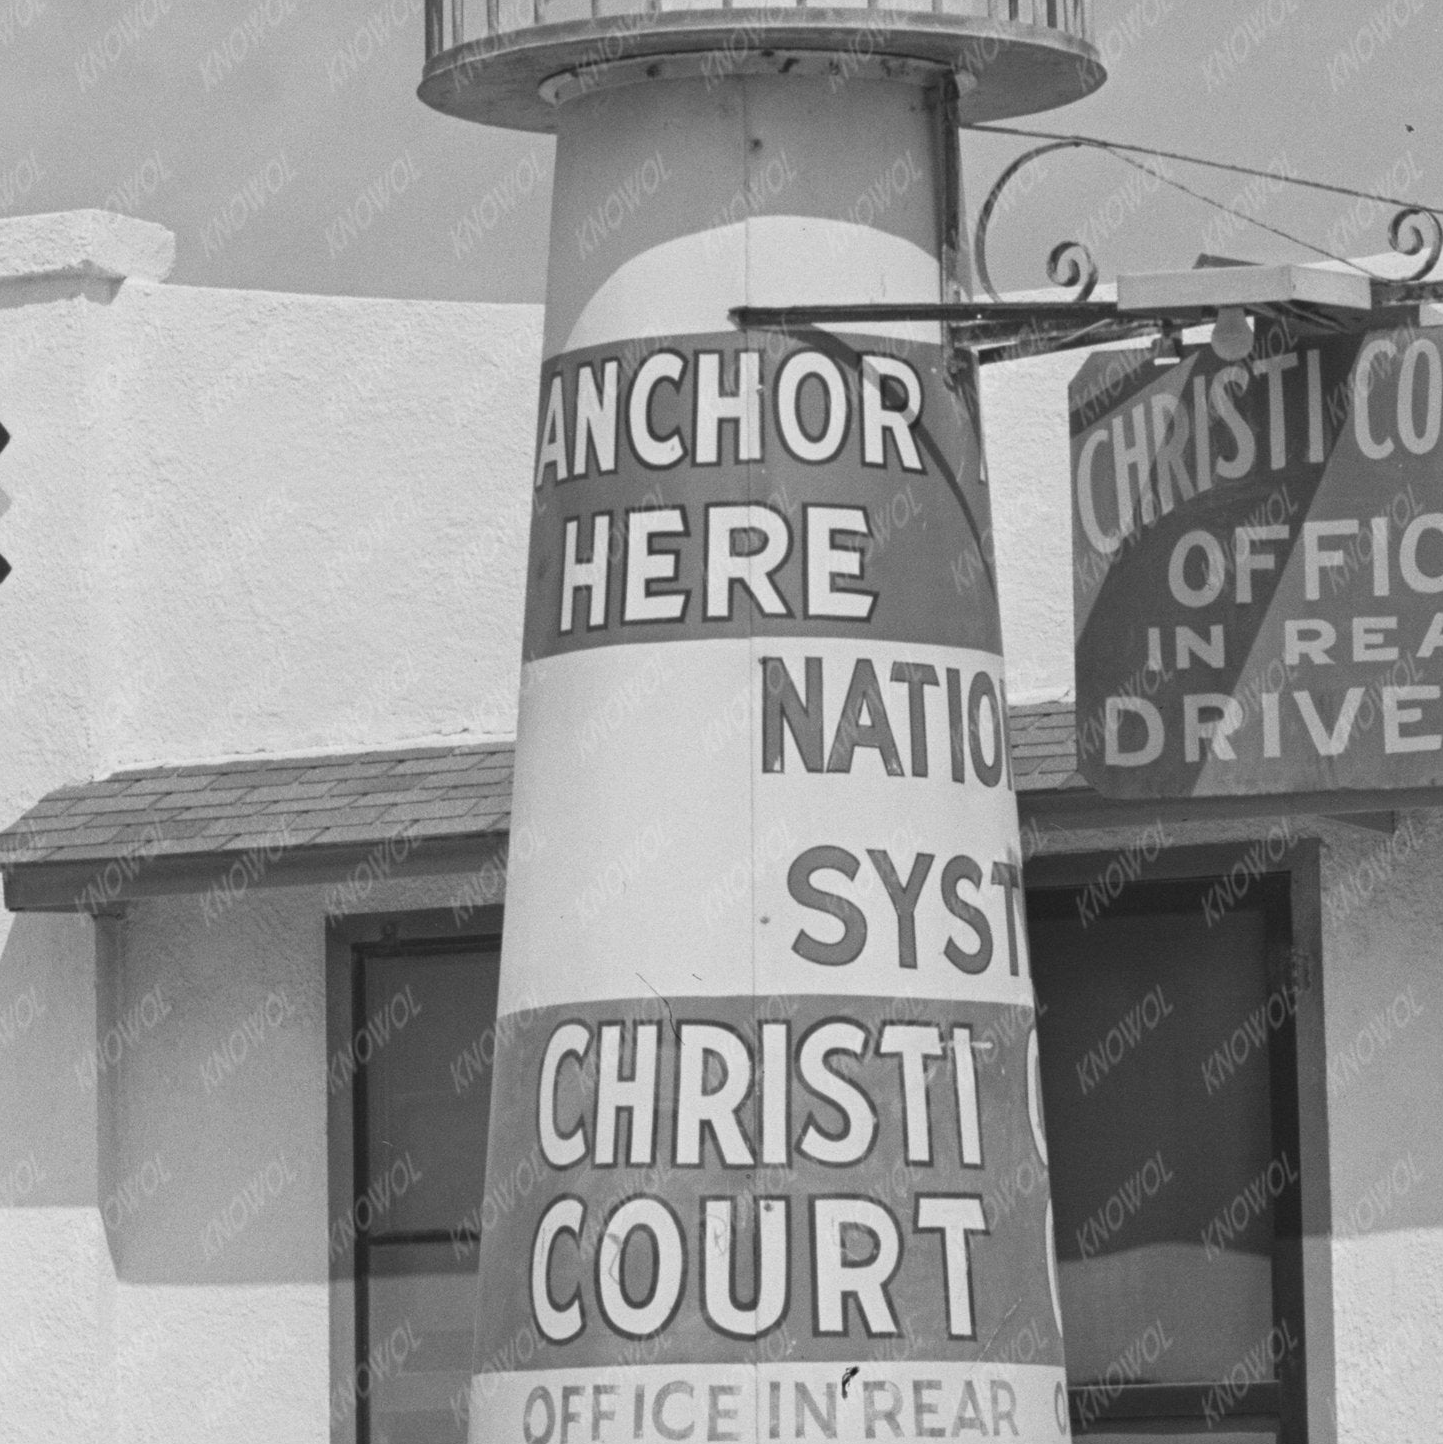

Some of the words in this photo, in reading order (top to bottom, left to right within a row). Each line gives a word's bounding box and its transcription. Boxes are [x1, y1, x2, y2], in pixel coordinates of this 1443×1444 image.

[535, 348, 927, 491] ANCHOR
[1076, 349, 1324, 554] CHRISTI
[558, 502, 880, 634] HERE
[1148, 624, 1226, 670] IN
[761, 656, 1012, 791] NATIO
[1105, 685, 1443, 766] DRIVE
[787, 845, 1019, 976] SYST
[536, 1017, 986, 1169] CHRISTI
[529, 1193, 991, 1343] COURT
[768, 1380, 838, 1439] IN
[863, 1379, 1020, 1439] REAR
